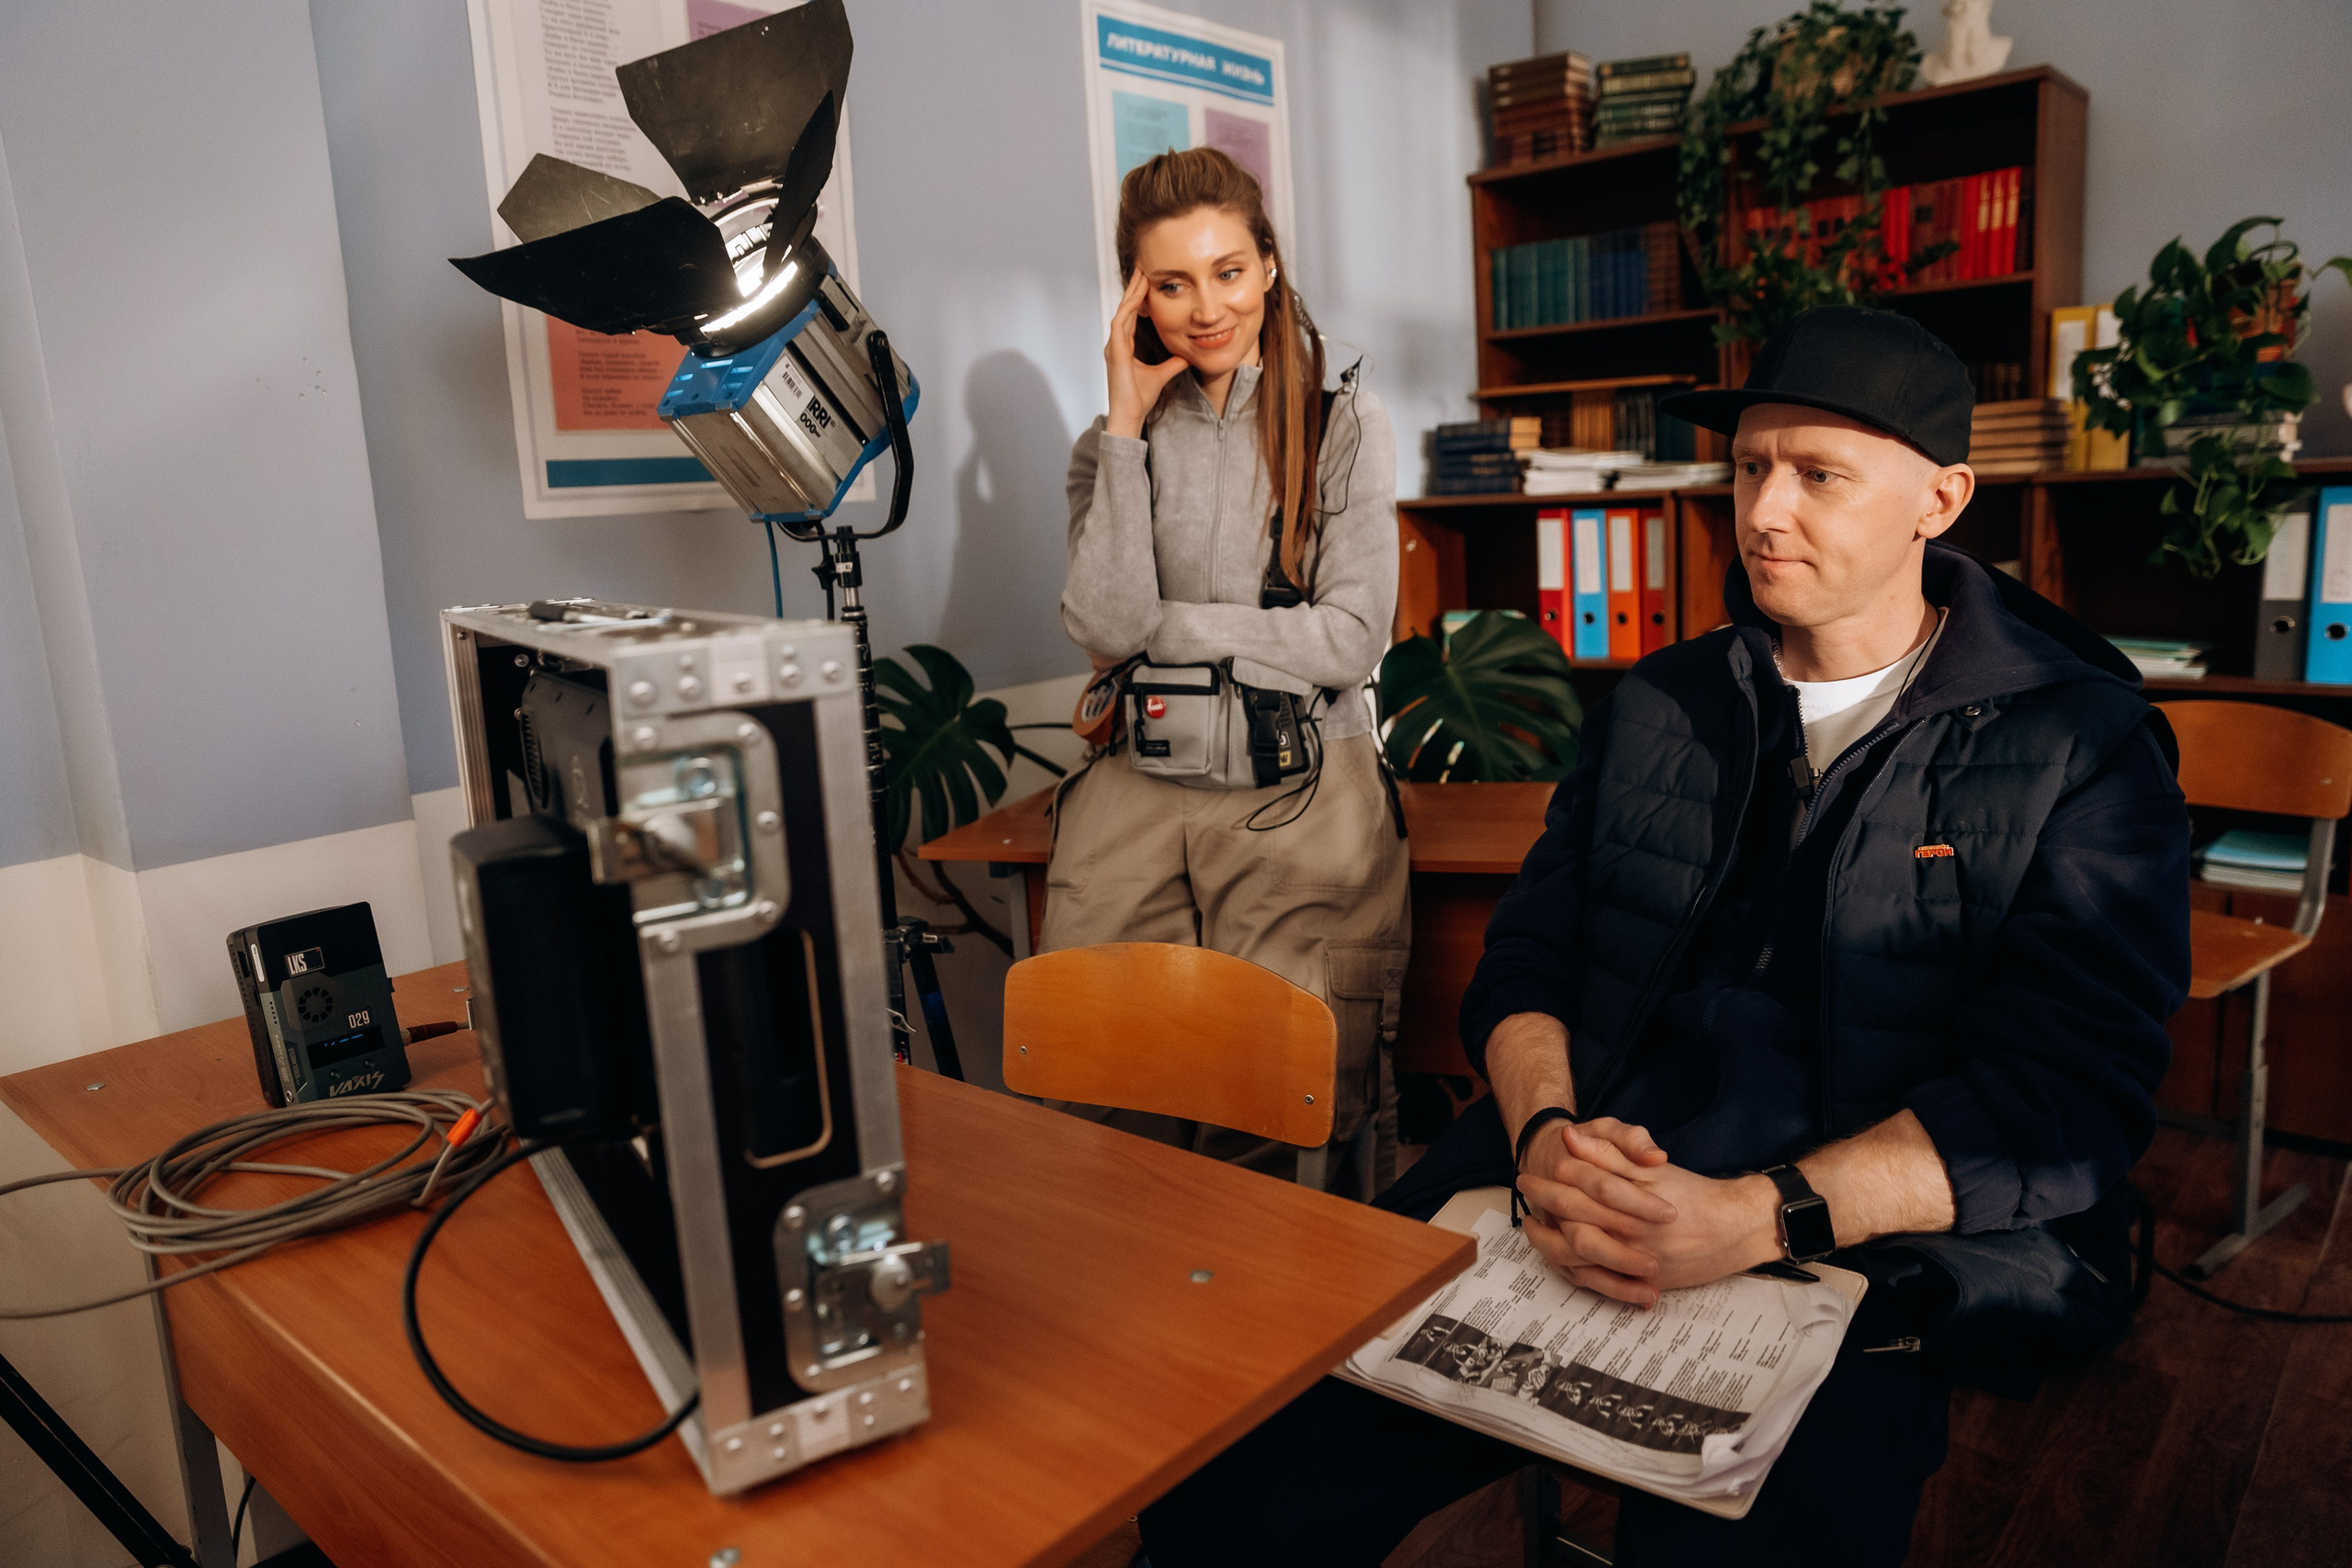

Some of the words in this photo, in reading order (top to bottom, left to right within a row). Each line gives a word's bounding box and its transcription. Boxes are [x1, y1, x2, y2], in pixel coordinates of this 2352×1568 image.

[1107, 33, 1216, 71] ЛИТЕРАТУРНАЯ
[1222, 61, 1265, 85] ЖИЗНЬ
[807, 396, 831, 429] RRI
[287, 953, 308, 976] LKS
[348, 1010, 371, 1029] 029
[329, 1070, 386, 1097] VAXIS
